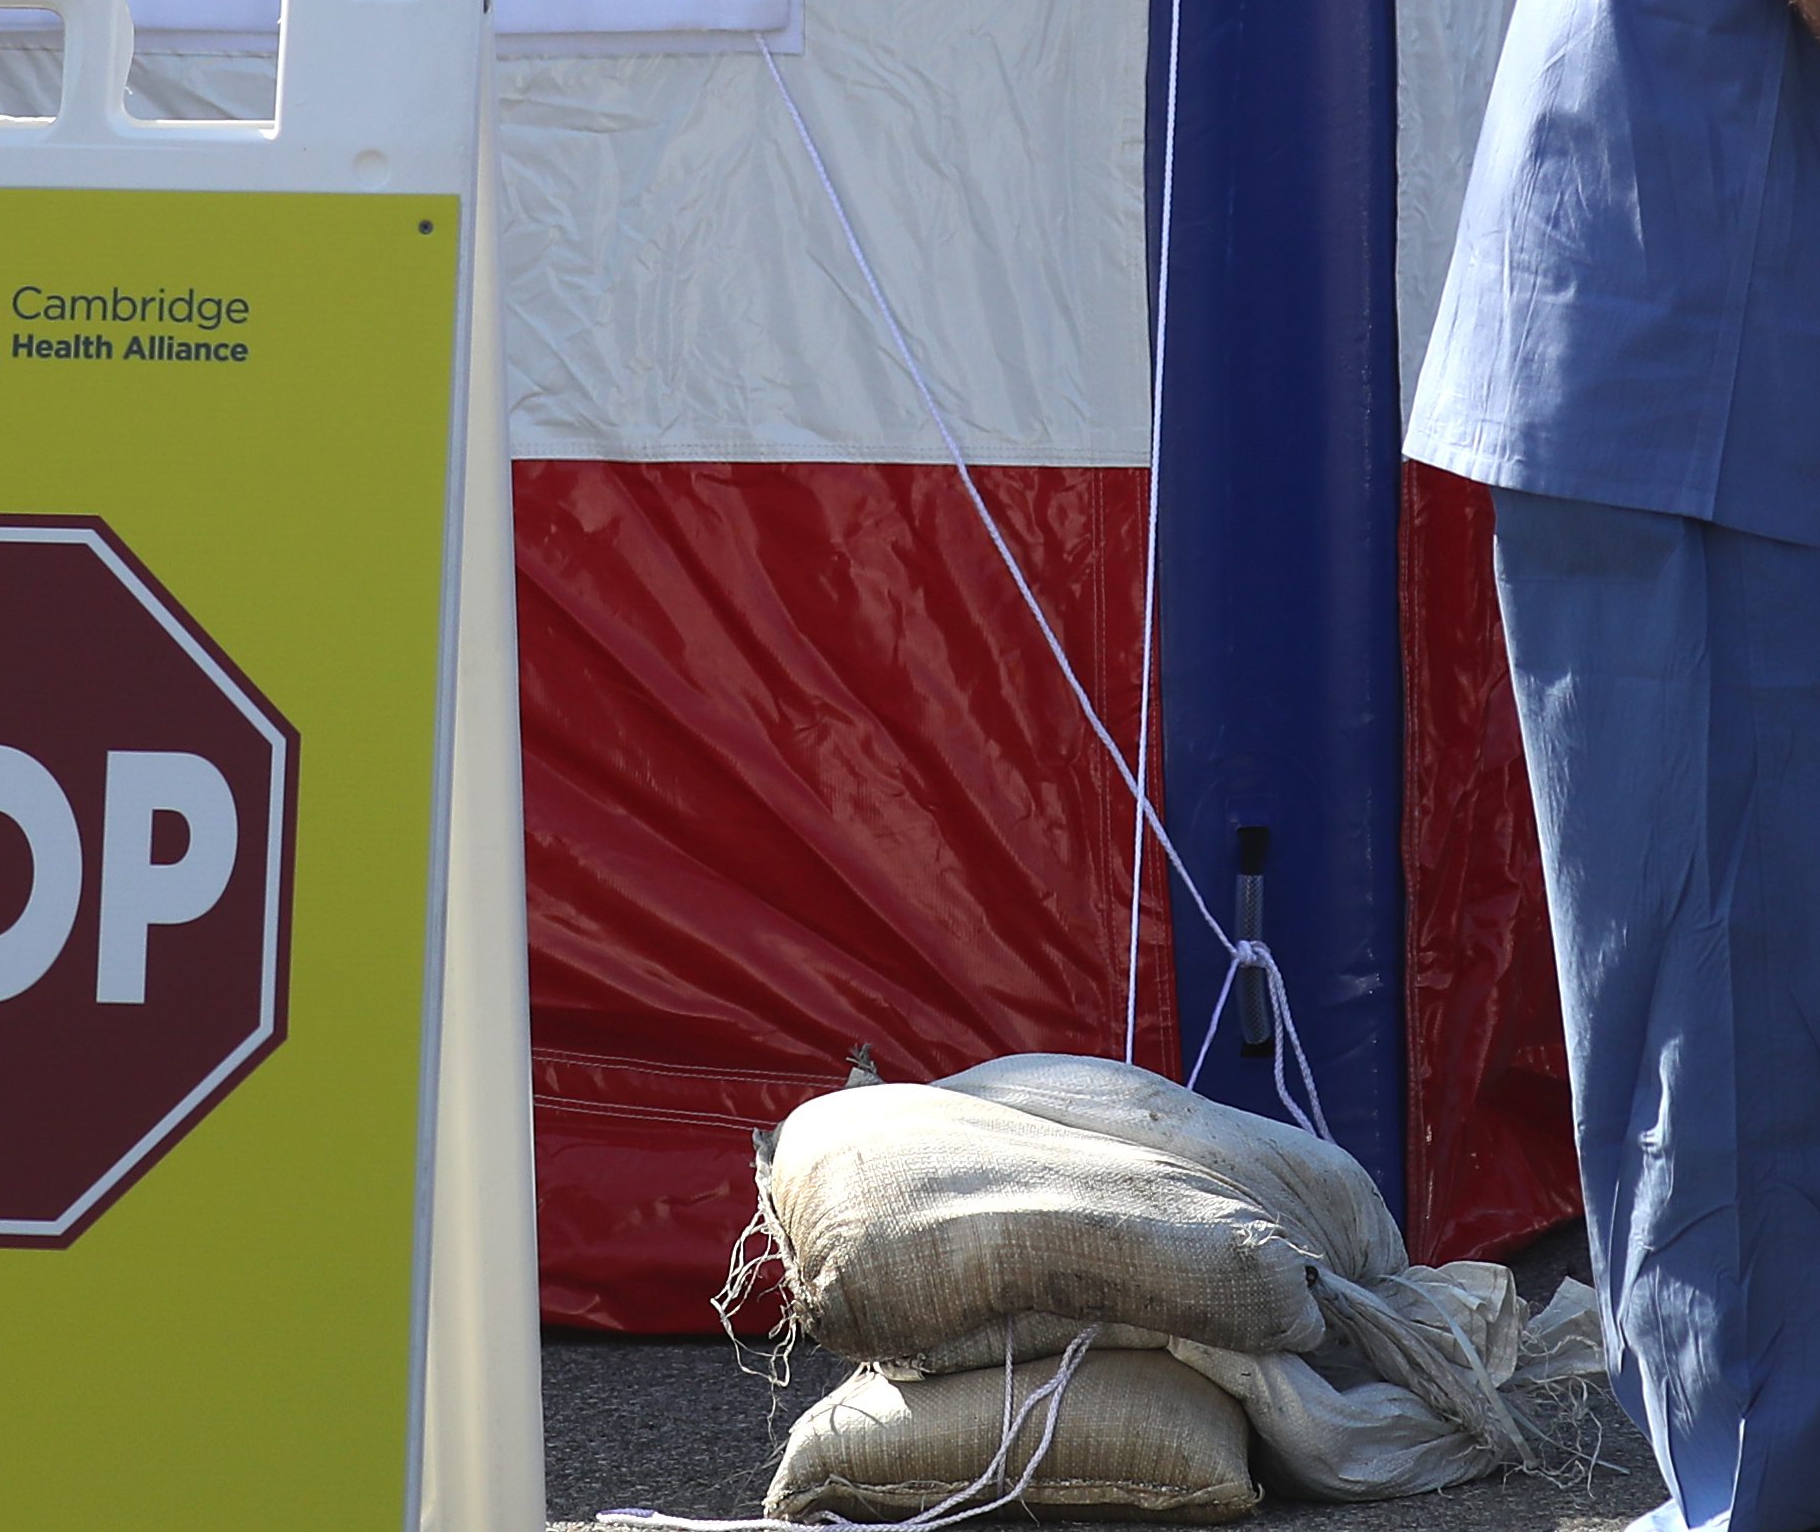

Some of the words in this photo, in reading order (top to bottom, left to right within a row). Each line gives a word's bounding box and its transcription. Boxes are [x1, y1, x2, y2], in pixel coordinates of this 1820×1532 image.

[12, 285, 249, 331] Cambridge
[12, 334, 112, 361] Health
[123, 335, 248, 363] Alliance
